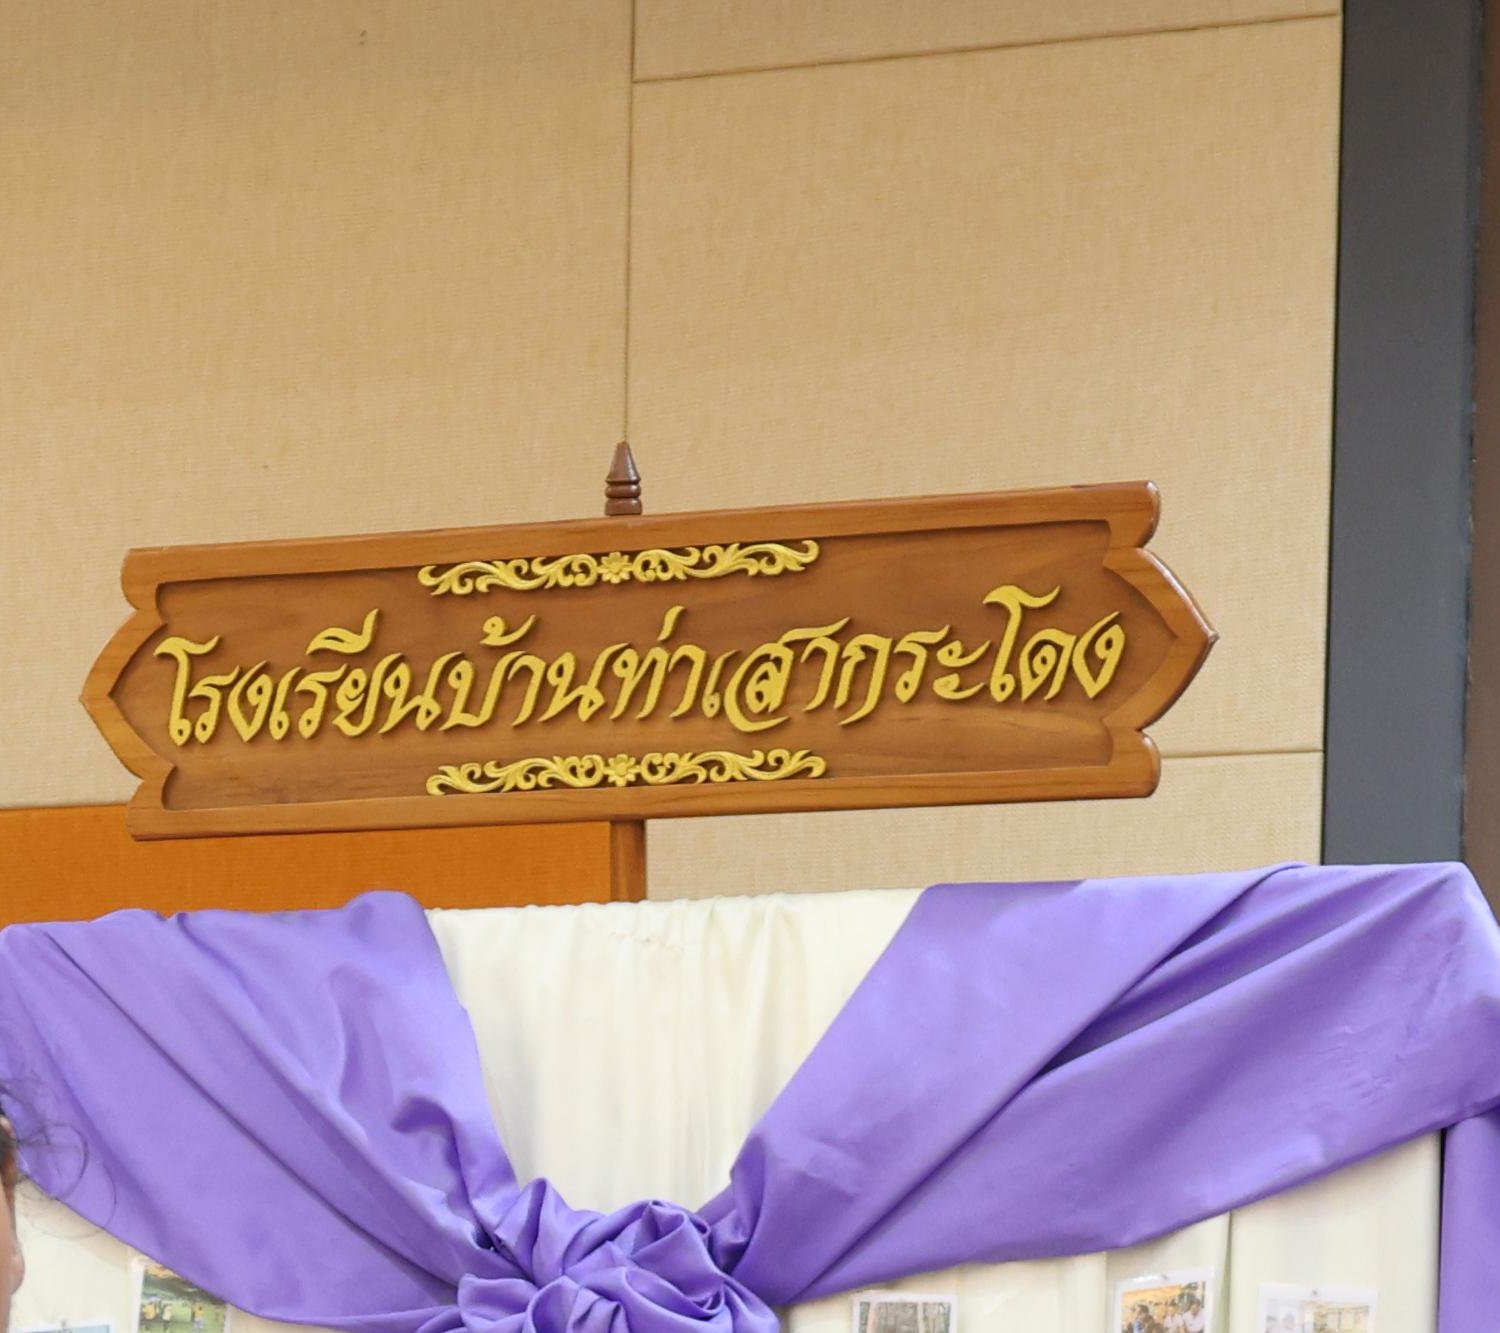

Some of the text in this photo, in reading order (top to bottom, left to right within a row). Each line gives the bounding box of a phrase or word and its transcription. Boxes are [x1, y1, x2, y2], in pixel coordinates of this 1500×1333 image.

[153, 584, 1128, 748] โรงเรียนบ้านท่าเสากระโดง
